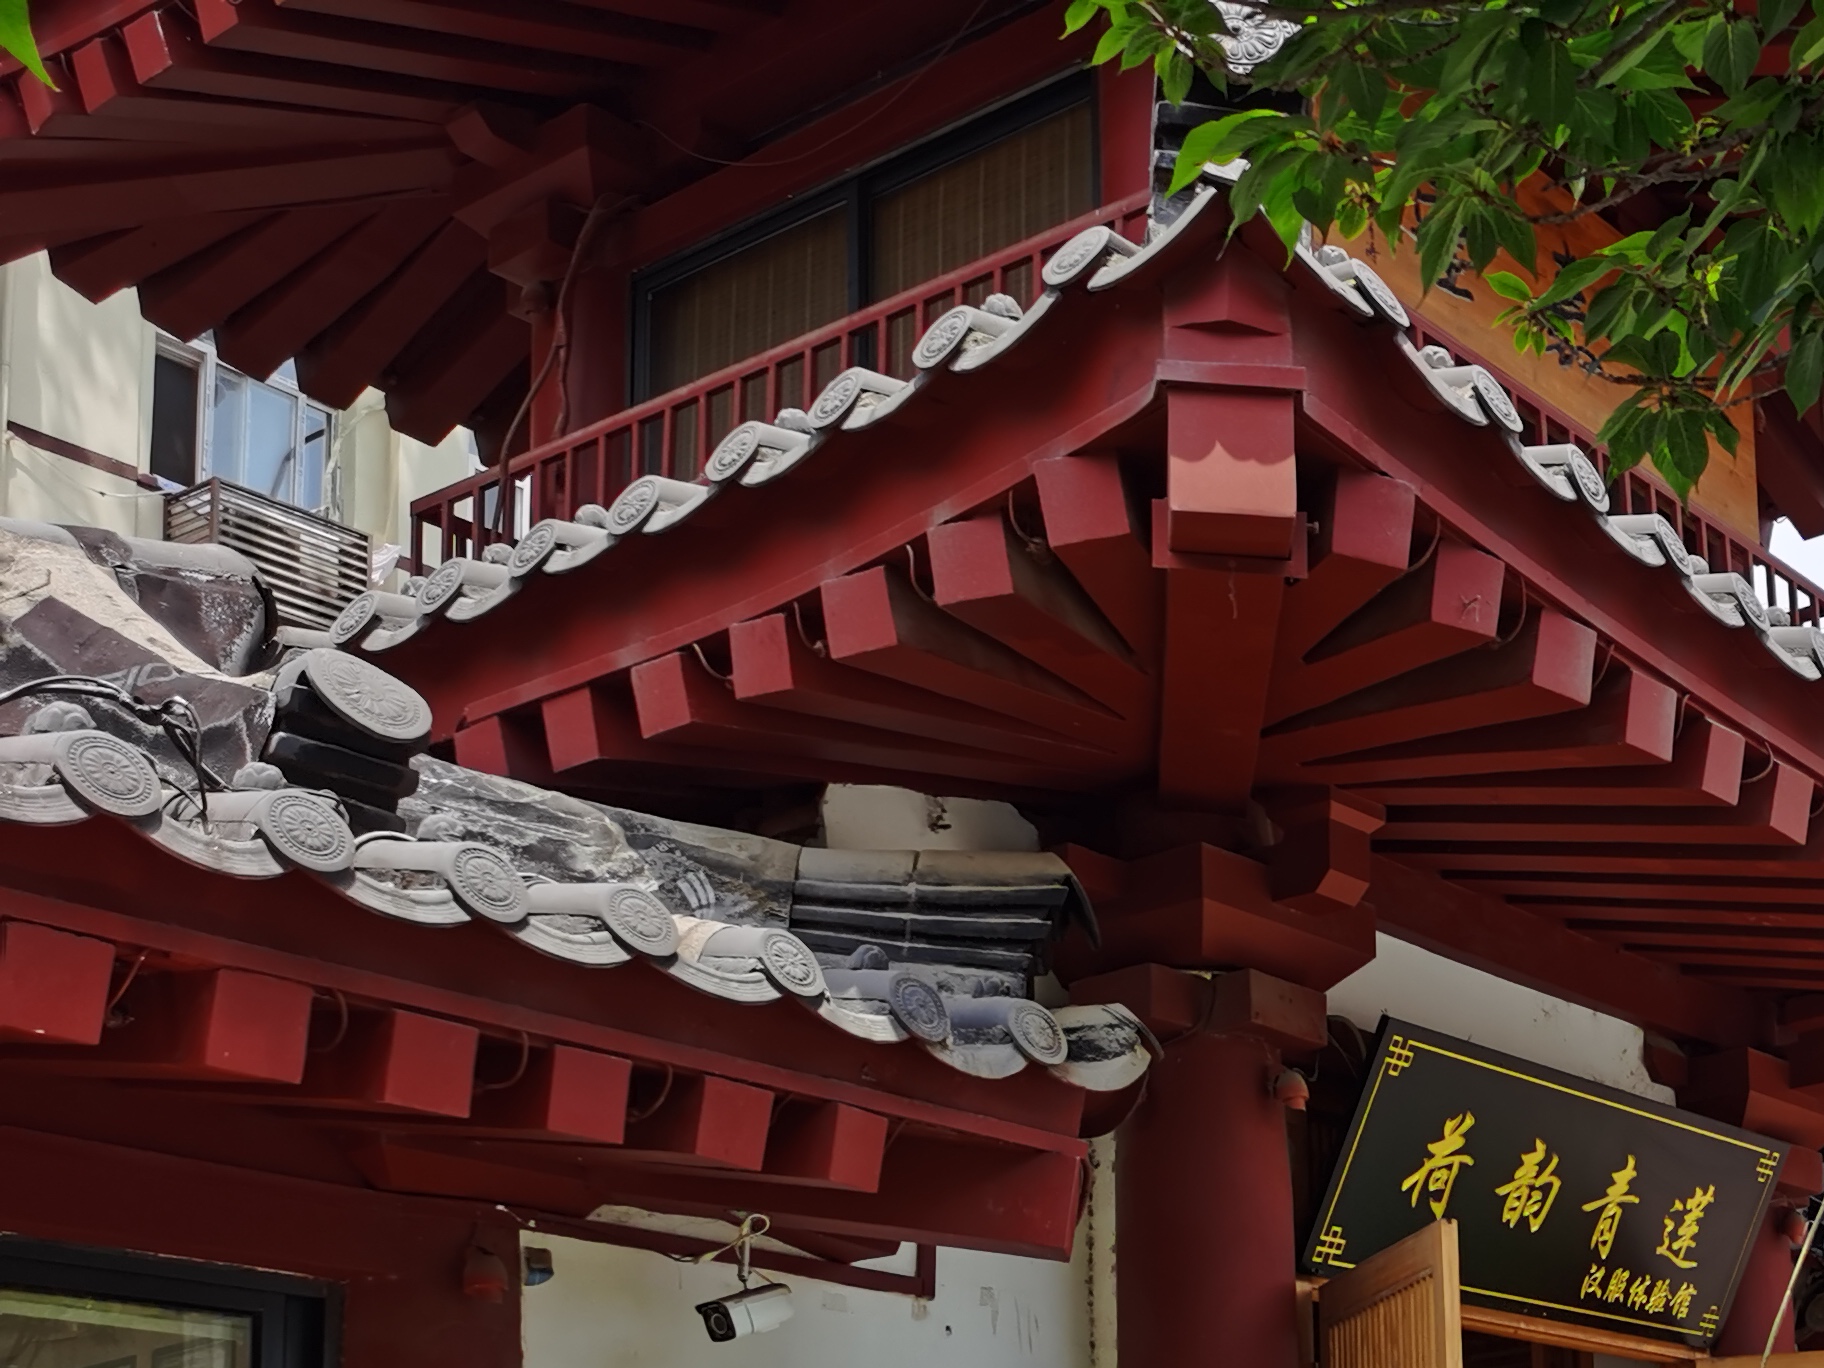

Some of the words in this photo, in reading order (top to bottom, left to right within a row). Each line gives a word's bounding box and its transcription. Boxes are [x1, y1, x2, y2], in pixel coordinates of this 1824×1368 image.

[1400, 1109, 1717, 1269] 荷韵青莲
[1579, 1262, 1700, 1320] 汉服体验馆
